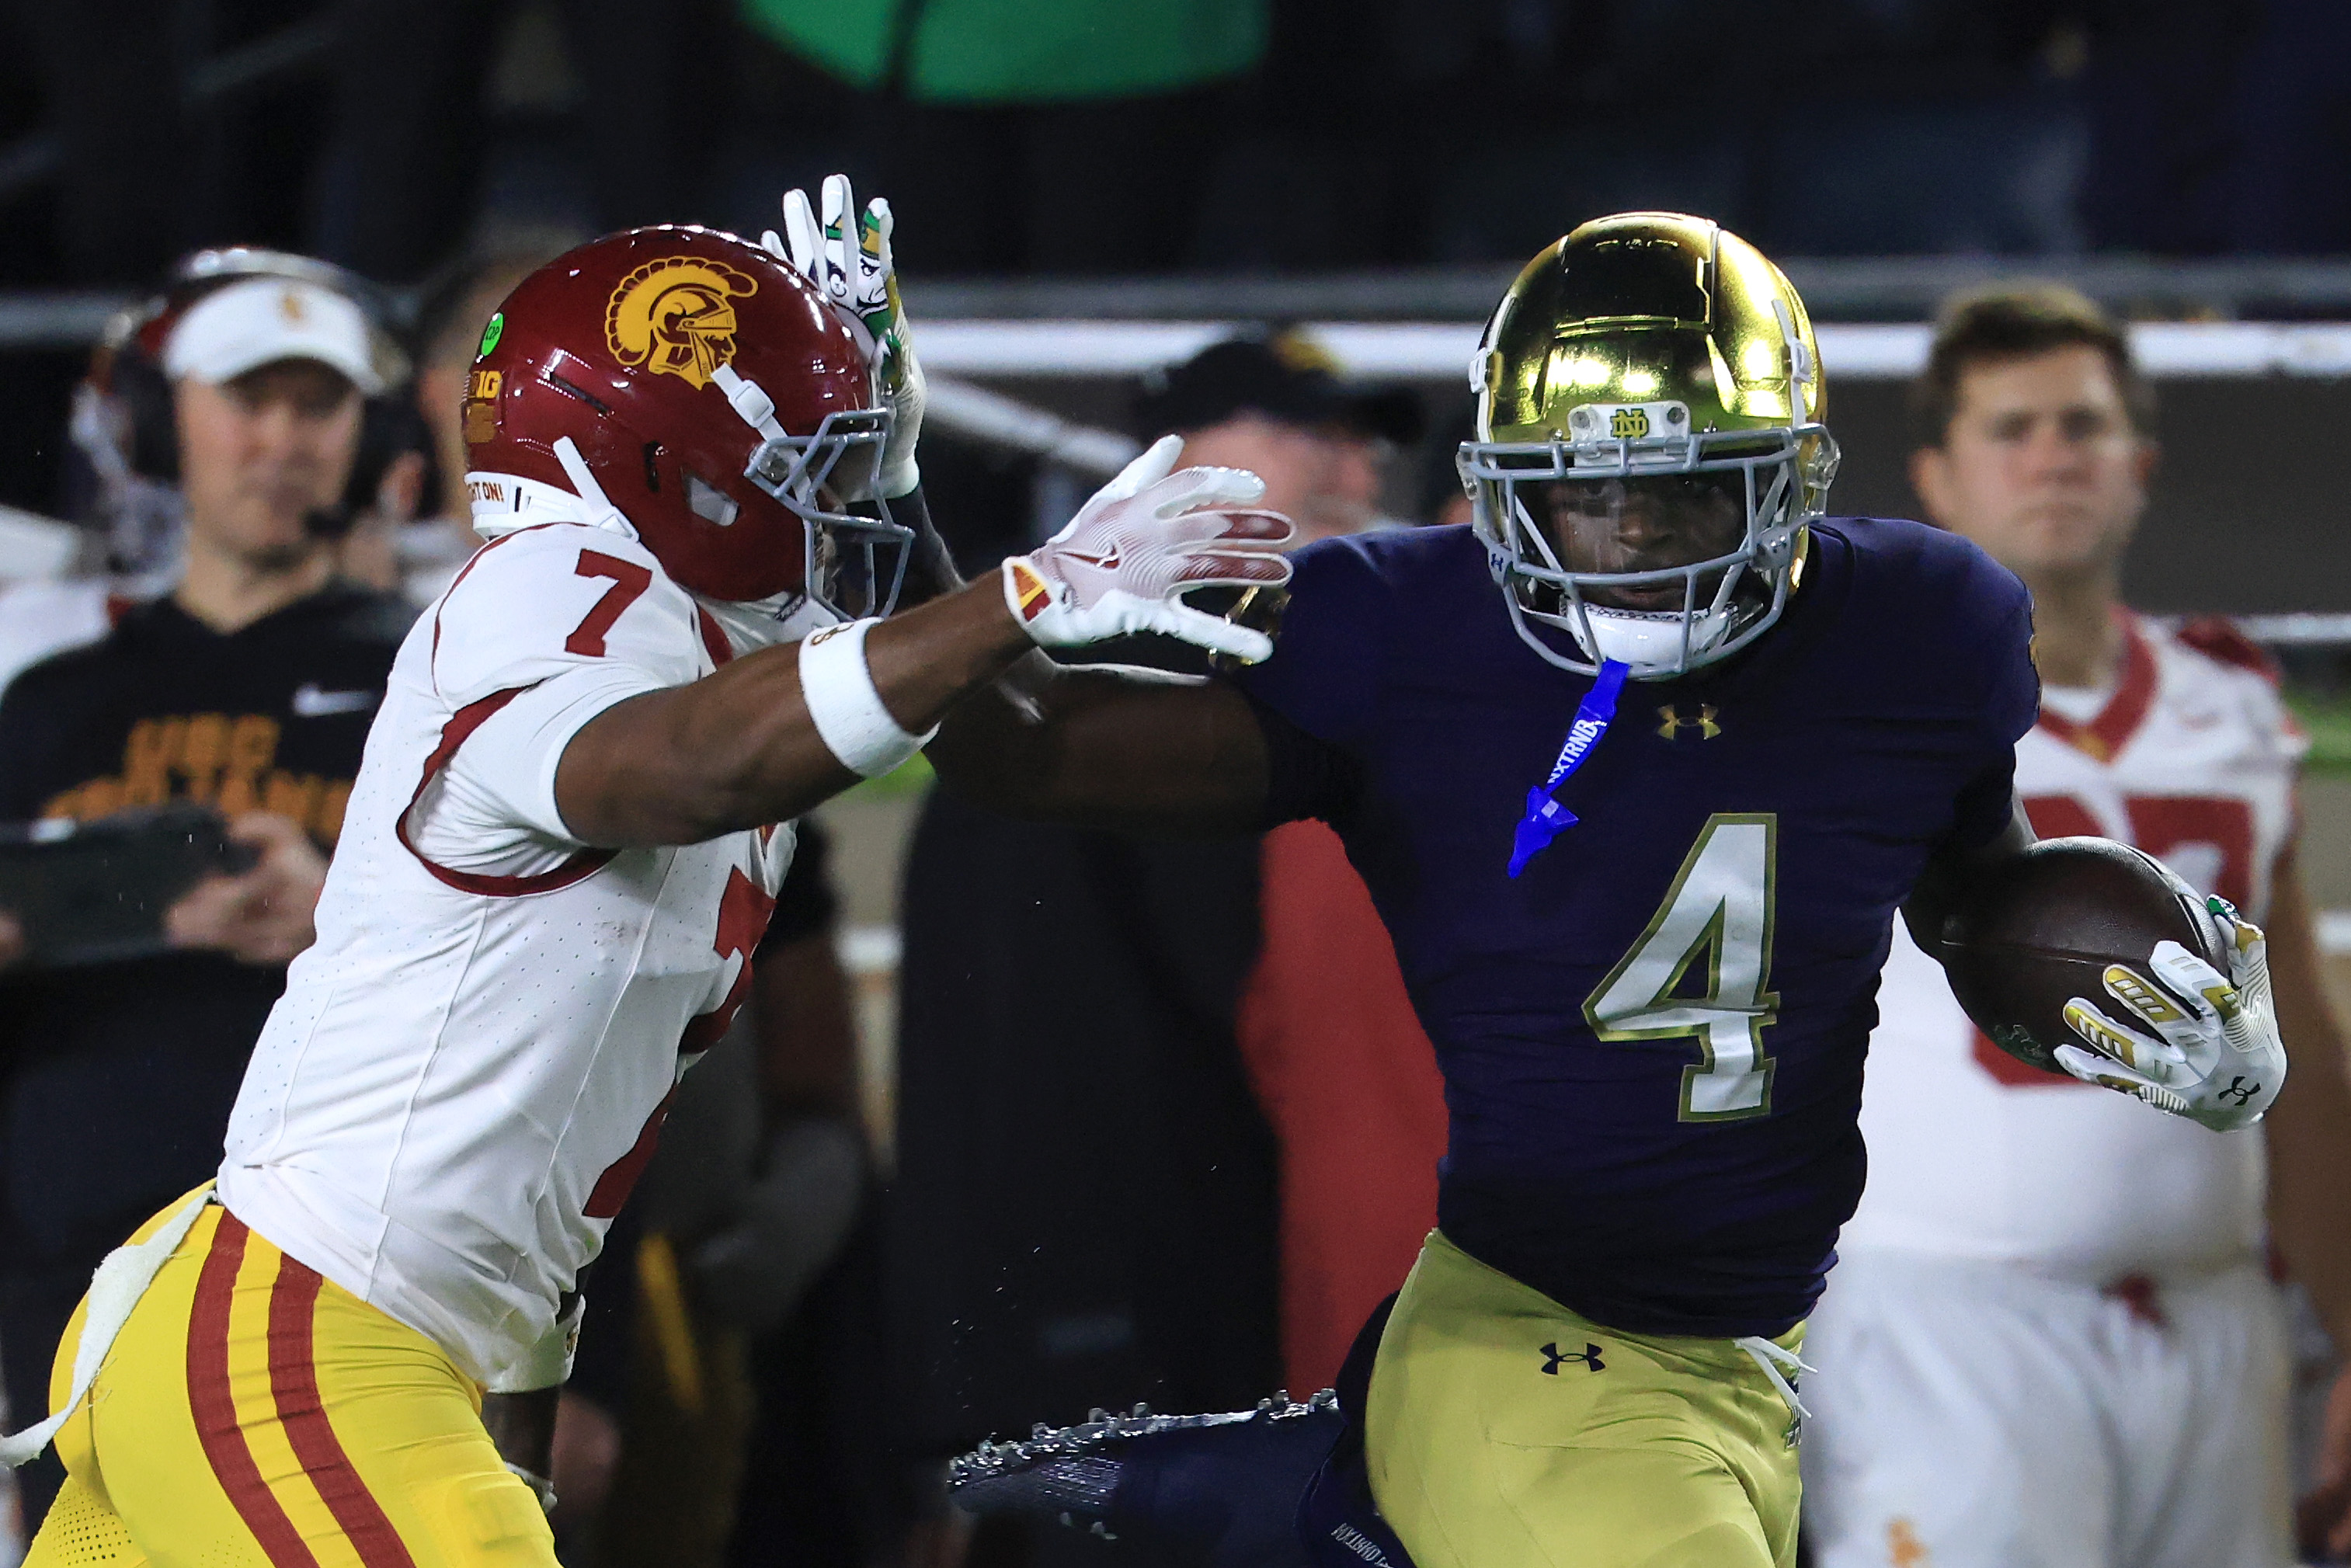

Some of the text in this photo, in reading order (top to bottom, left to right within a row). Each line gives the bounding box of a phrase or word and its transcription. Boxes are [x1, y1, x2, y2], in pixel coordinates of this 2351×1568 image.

[1610, 409, 1649, 439] ND
[482, 482, 504, 503] ON!
[565, 548, 652, 657] 7
[1547, 719, 1598, 784] NXTRND
[1581, 812, 1781, 1123] 4
